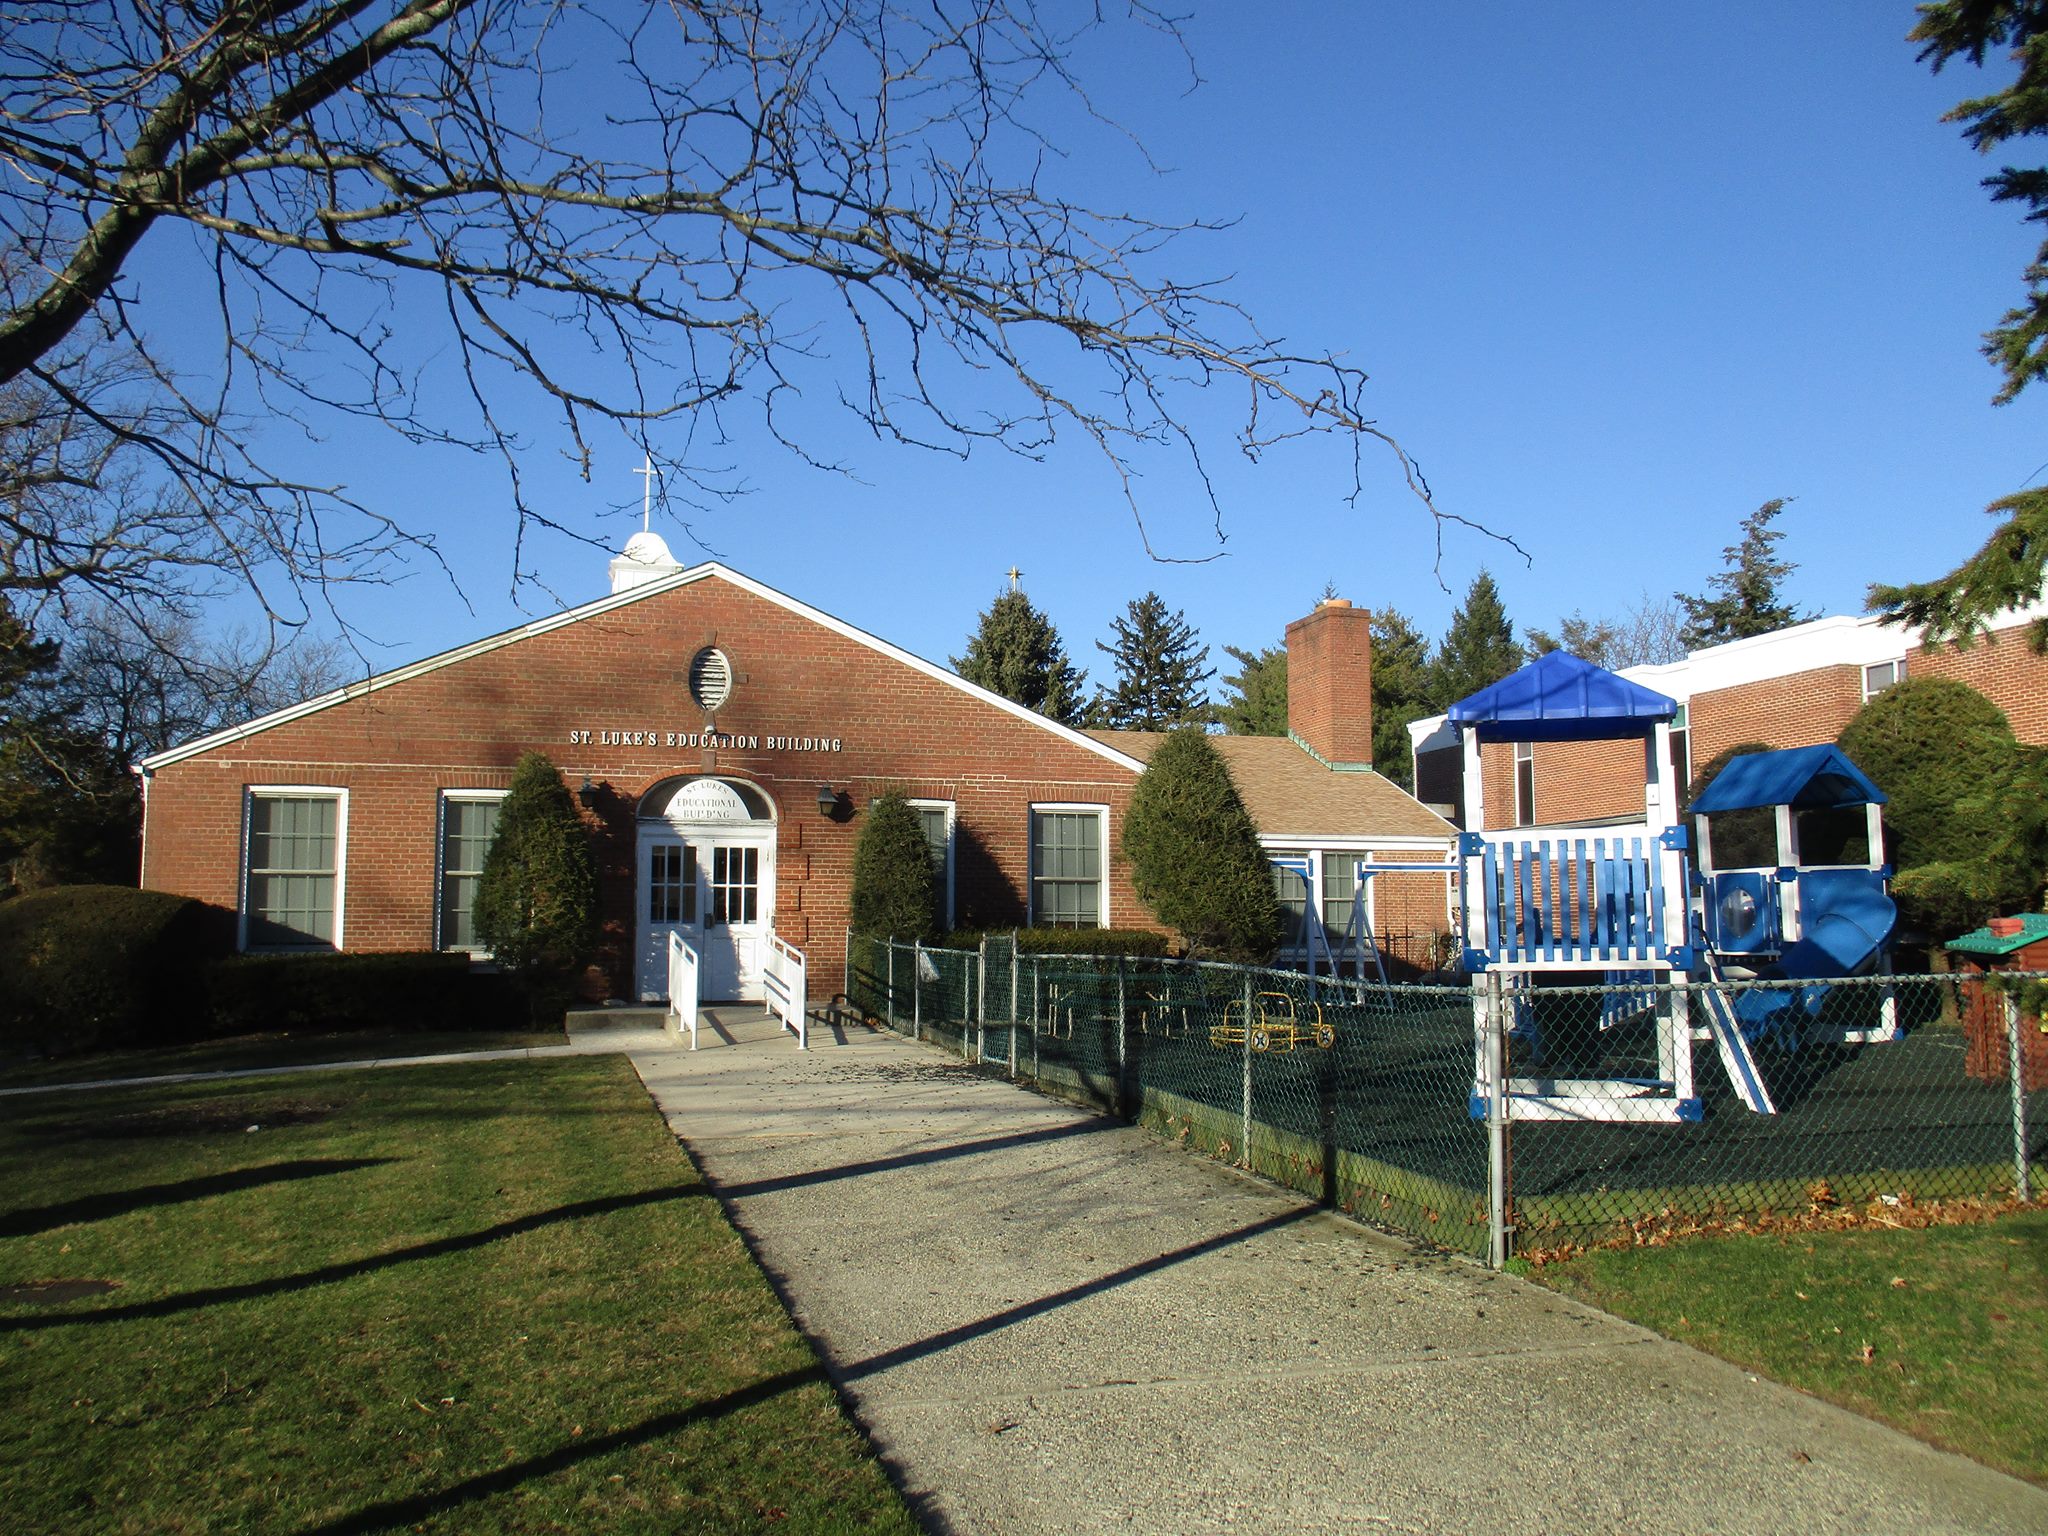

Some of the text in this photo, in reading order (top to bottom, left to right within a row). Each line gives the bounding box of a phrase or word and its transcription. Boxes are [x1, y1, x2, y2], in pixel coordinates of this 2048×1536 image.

[570, 730, 842, 753] ST. LUKE'S EDUCATION BUILDING
[677, 798, 738, 808] EDUCATIONAL
